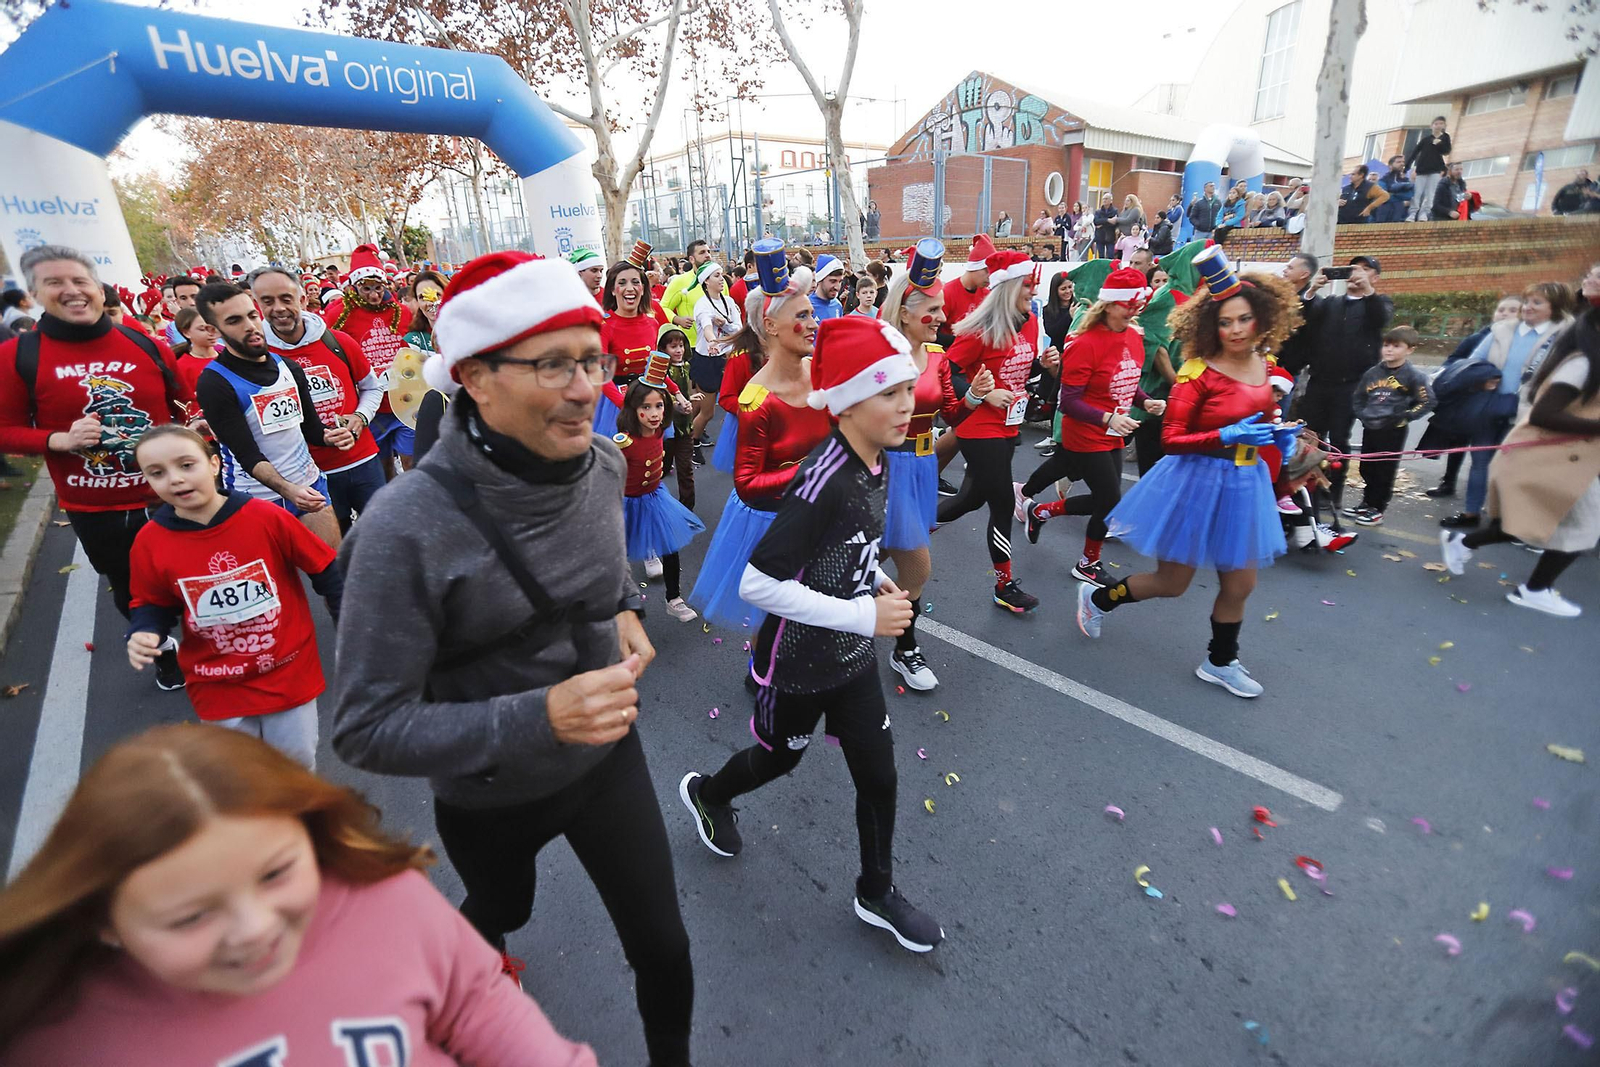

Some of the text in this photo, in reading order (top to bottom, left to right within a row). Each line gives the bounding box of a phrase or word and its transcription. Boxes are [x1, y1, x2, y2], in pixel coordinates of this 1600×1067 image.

[147, 25, 477, 104] Huelva original
[1, 195, 98, 216] Huelva
[550, 203, 595, 218] Huelva
[55, 361, 137, 379] MERRY
[270, 398, 293, 418] 325
[210, 581, 250, 609] 487
[216, 633, 276, 654] 2023
[194, 663, 245, 677] Huelva
